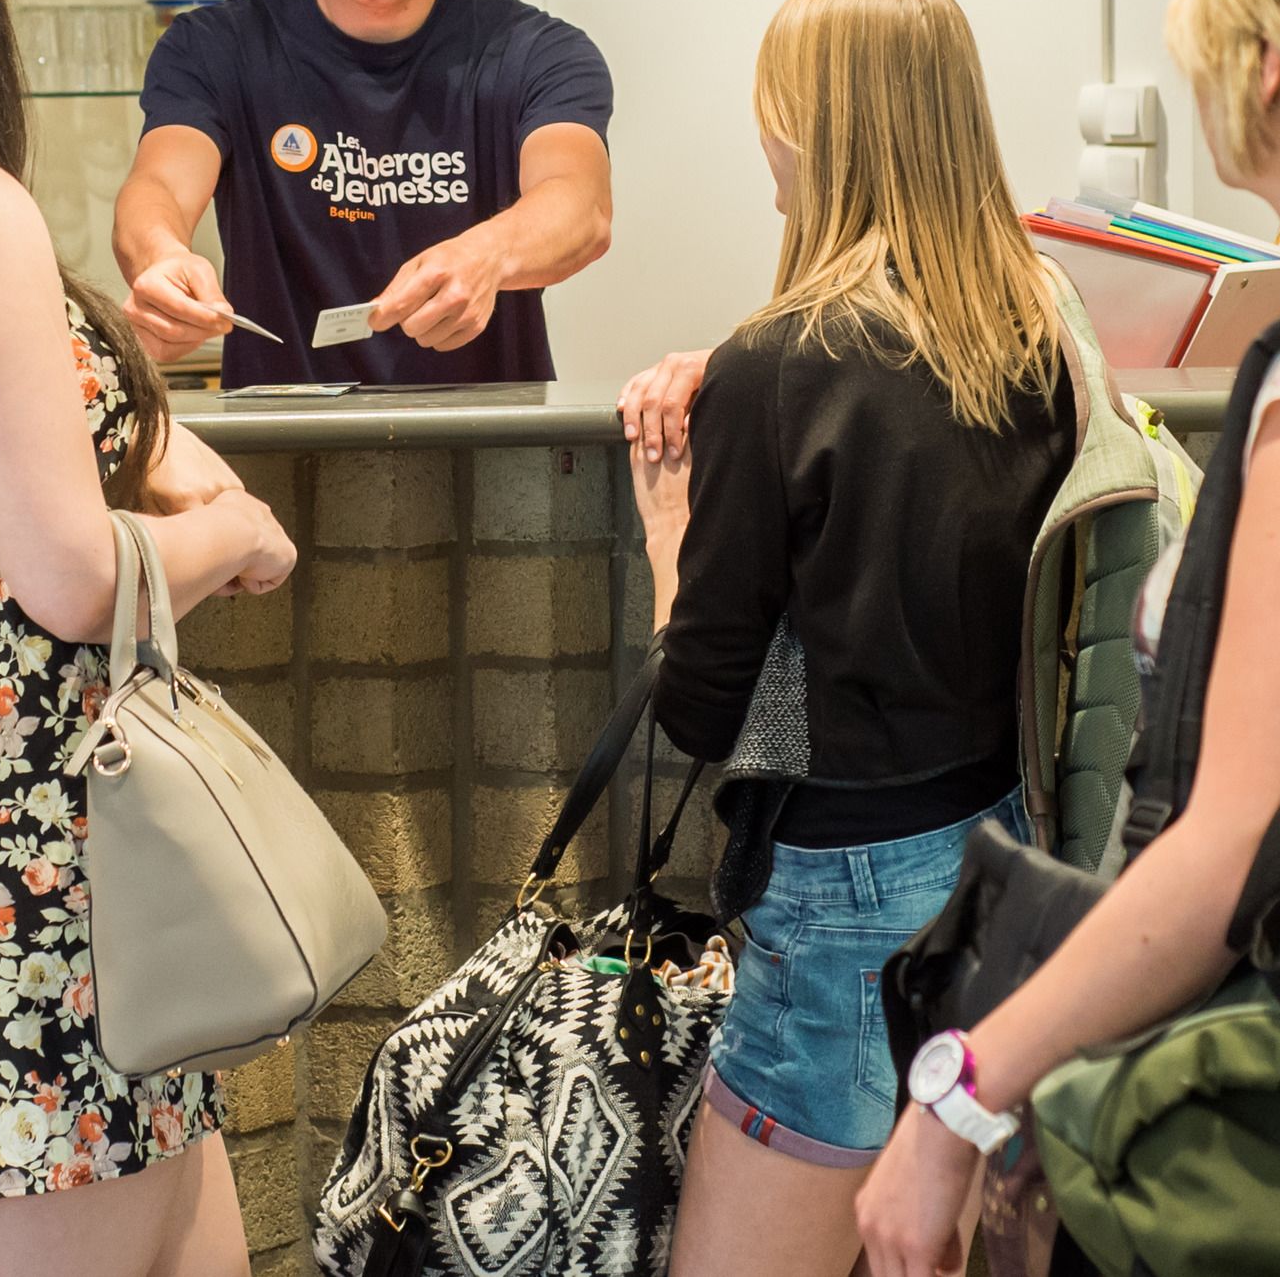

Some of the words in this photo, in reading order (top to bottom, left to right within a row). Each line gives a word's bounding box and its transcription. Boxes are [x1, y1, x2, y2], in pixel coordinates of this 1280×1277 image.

[336, 131, 360, 150] Les
[319, 143, 466, 182] Auberges
[310, 174, 333, 192] de
[330, 172, 469, 207] Jeunesse
[329, 206, 376, 223] Belgium
